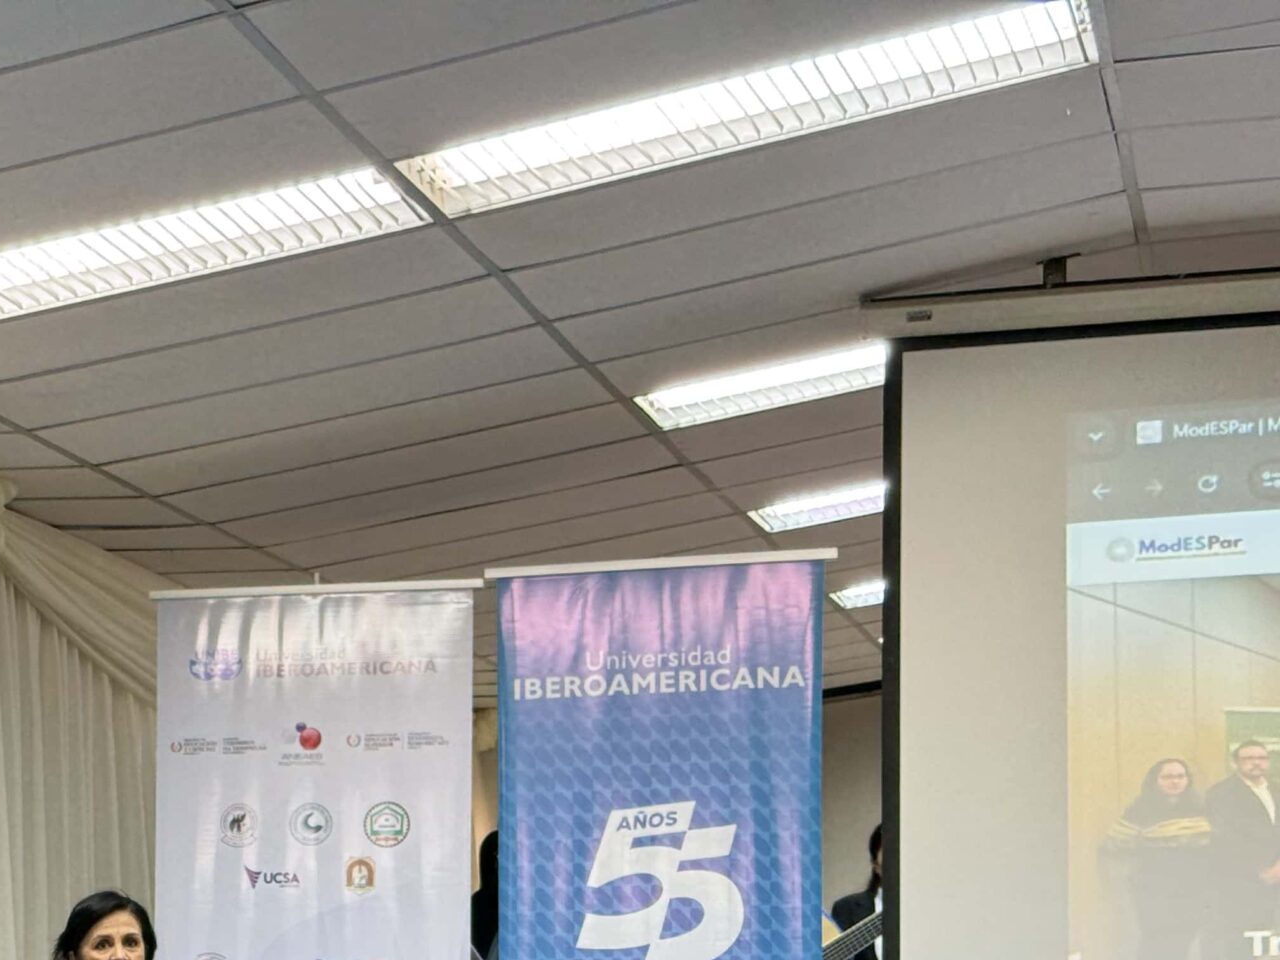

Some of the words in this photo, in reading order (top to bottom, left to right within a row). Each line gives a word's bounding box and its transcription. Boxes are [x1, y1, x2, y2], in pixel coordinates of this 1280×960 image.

[1173, 420, 1254, 438] ModESPar
[1138, 535, 1244, 555] ModESPar
[585, 644, 732, 671] Universidad
[256, 659, 438, 679] IBEROAMERICANA
[513, 665, 806, 701] IBEROAMERICANA
[616, 809, 679, 833] AÑOS
[263, 871, 301, 885] UCSA
